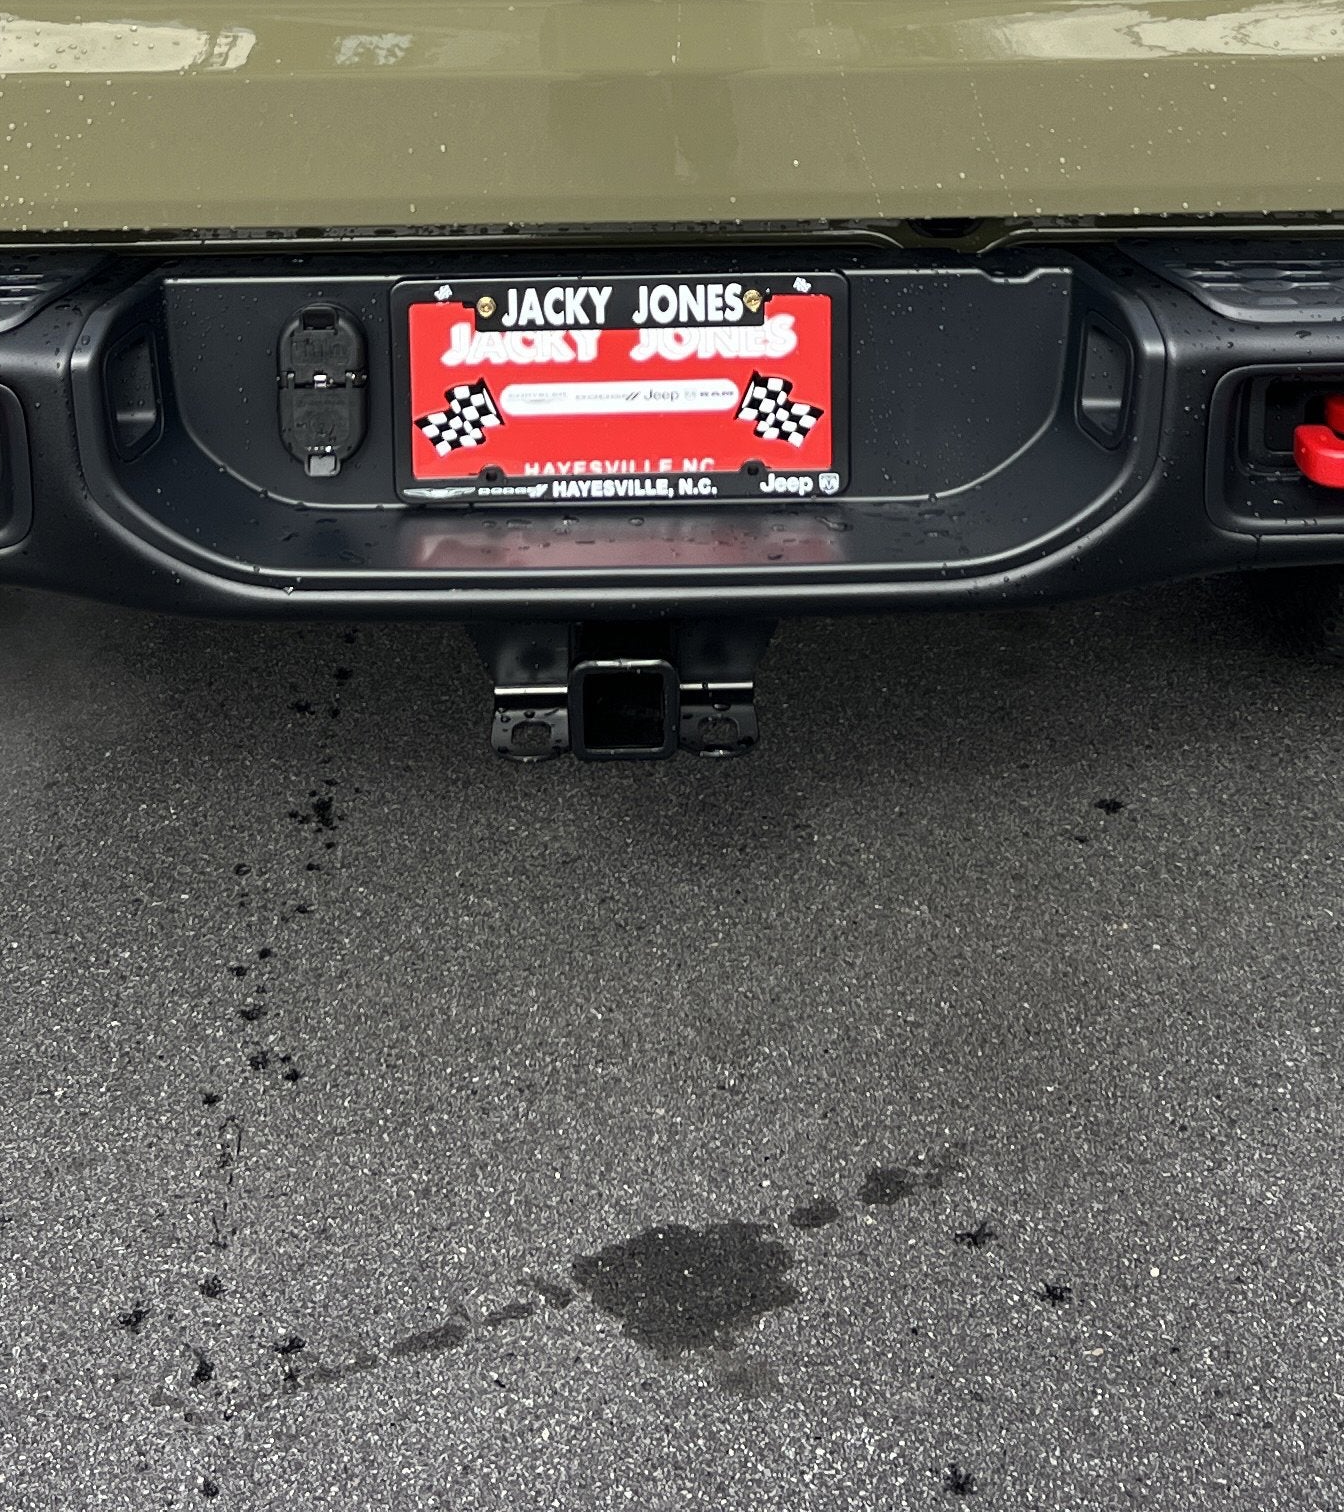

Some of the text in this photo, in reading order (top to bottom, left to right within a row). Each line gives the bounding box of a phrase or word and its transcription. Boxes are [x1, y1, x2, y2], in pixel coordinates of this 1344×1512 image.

[501, 283, 744, 327] JACKY JONES
[441, 314, 798, 367] JACKY JONES
[643, 388, 680, 402] Jeep
[552, 478, 674, 498] HAYESVILLE,
[678, 477, 718, 496] N.C.
[759, 473, 814, 496] Jeep
